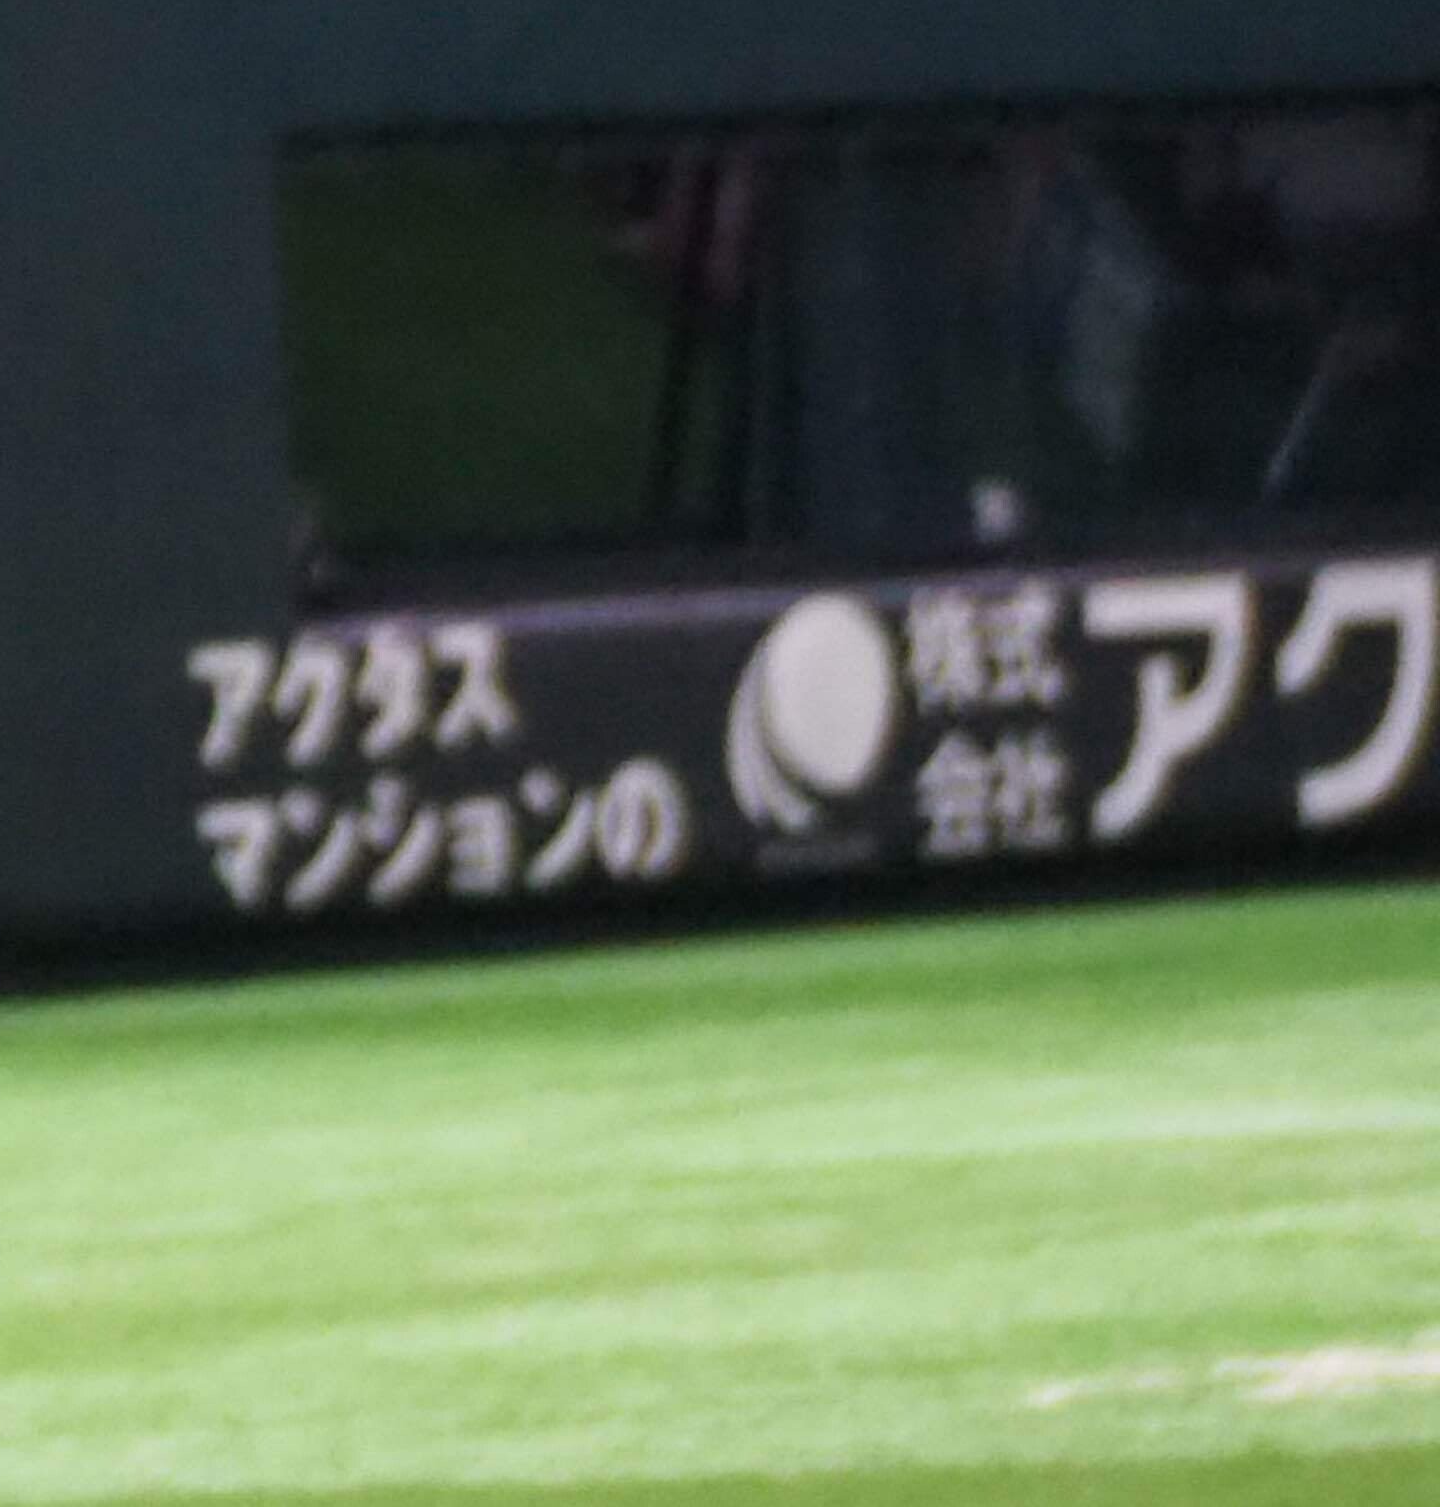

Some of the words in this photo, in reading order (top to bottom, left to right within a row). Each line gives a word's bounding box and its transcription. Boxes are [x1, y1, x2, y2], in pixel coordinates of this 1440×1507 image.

[186, 624, 518, 768] アクタス
[1082, 560, 1440, 836] アク
[194, 757, 690, 910] マンションの
[916, 732, 1068, 856] 会社
